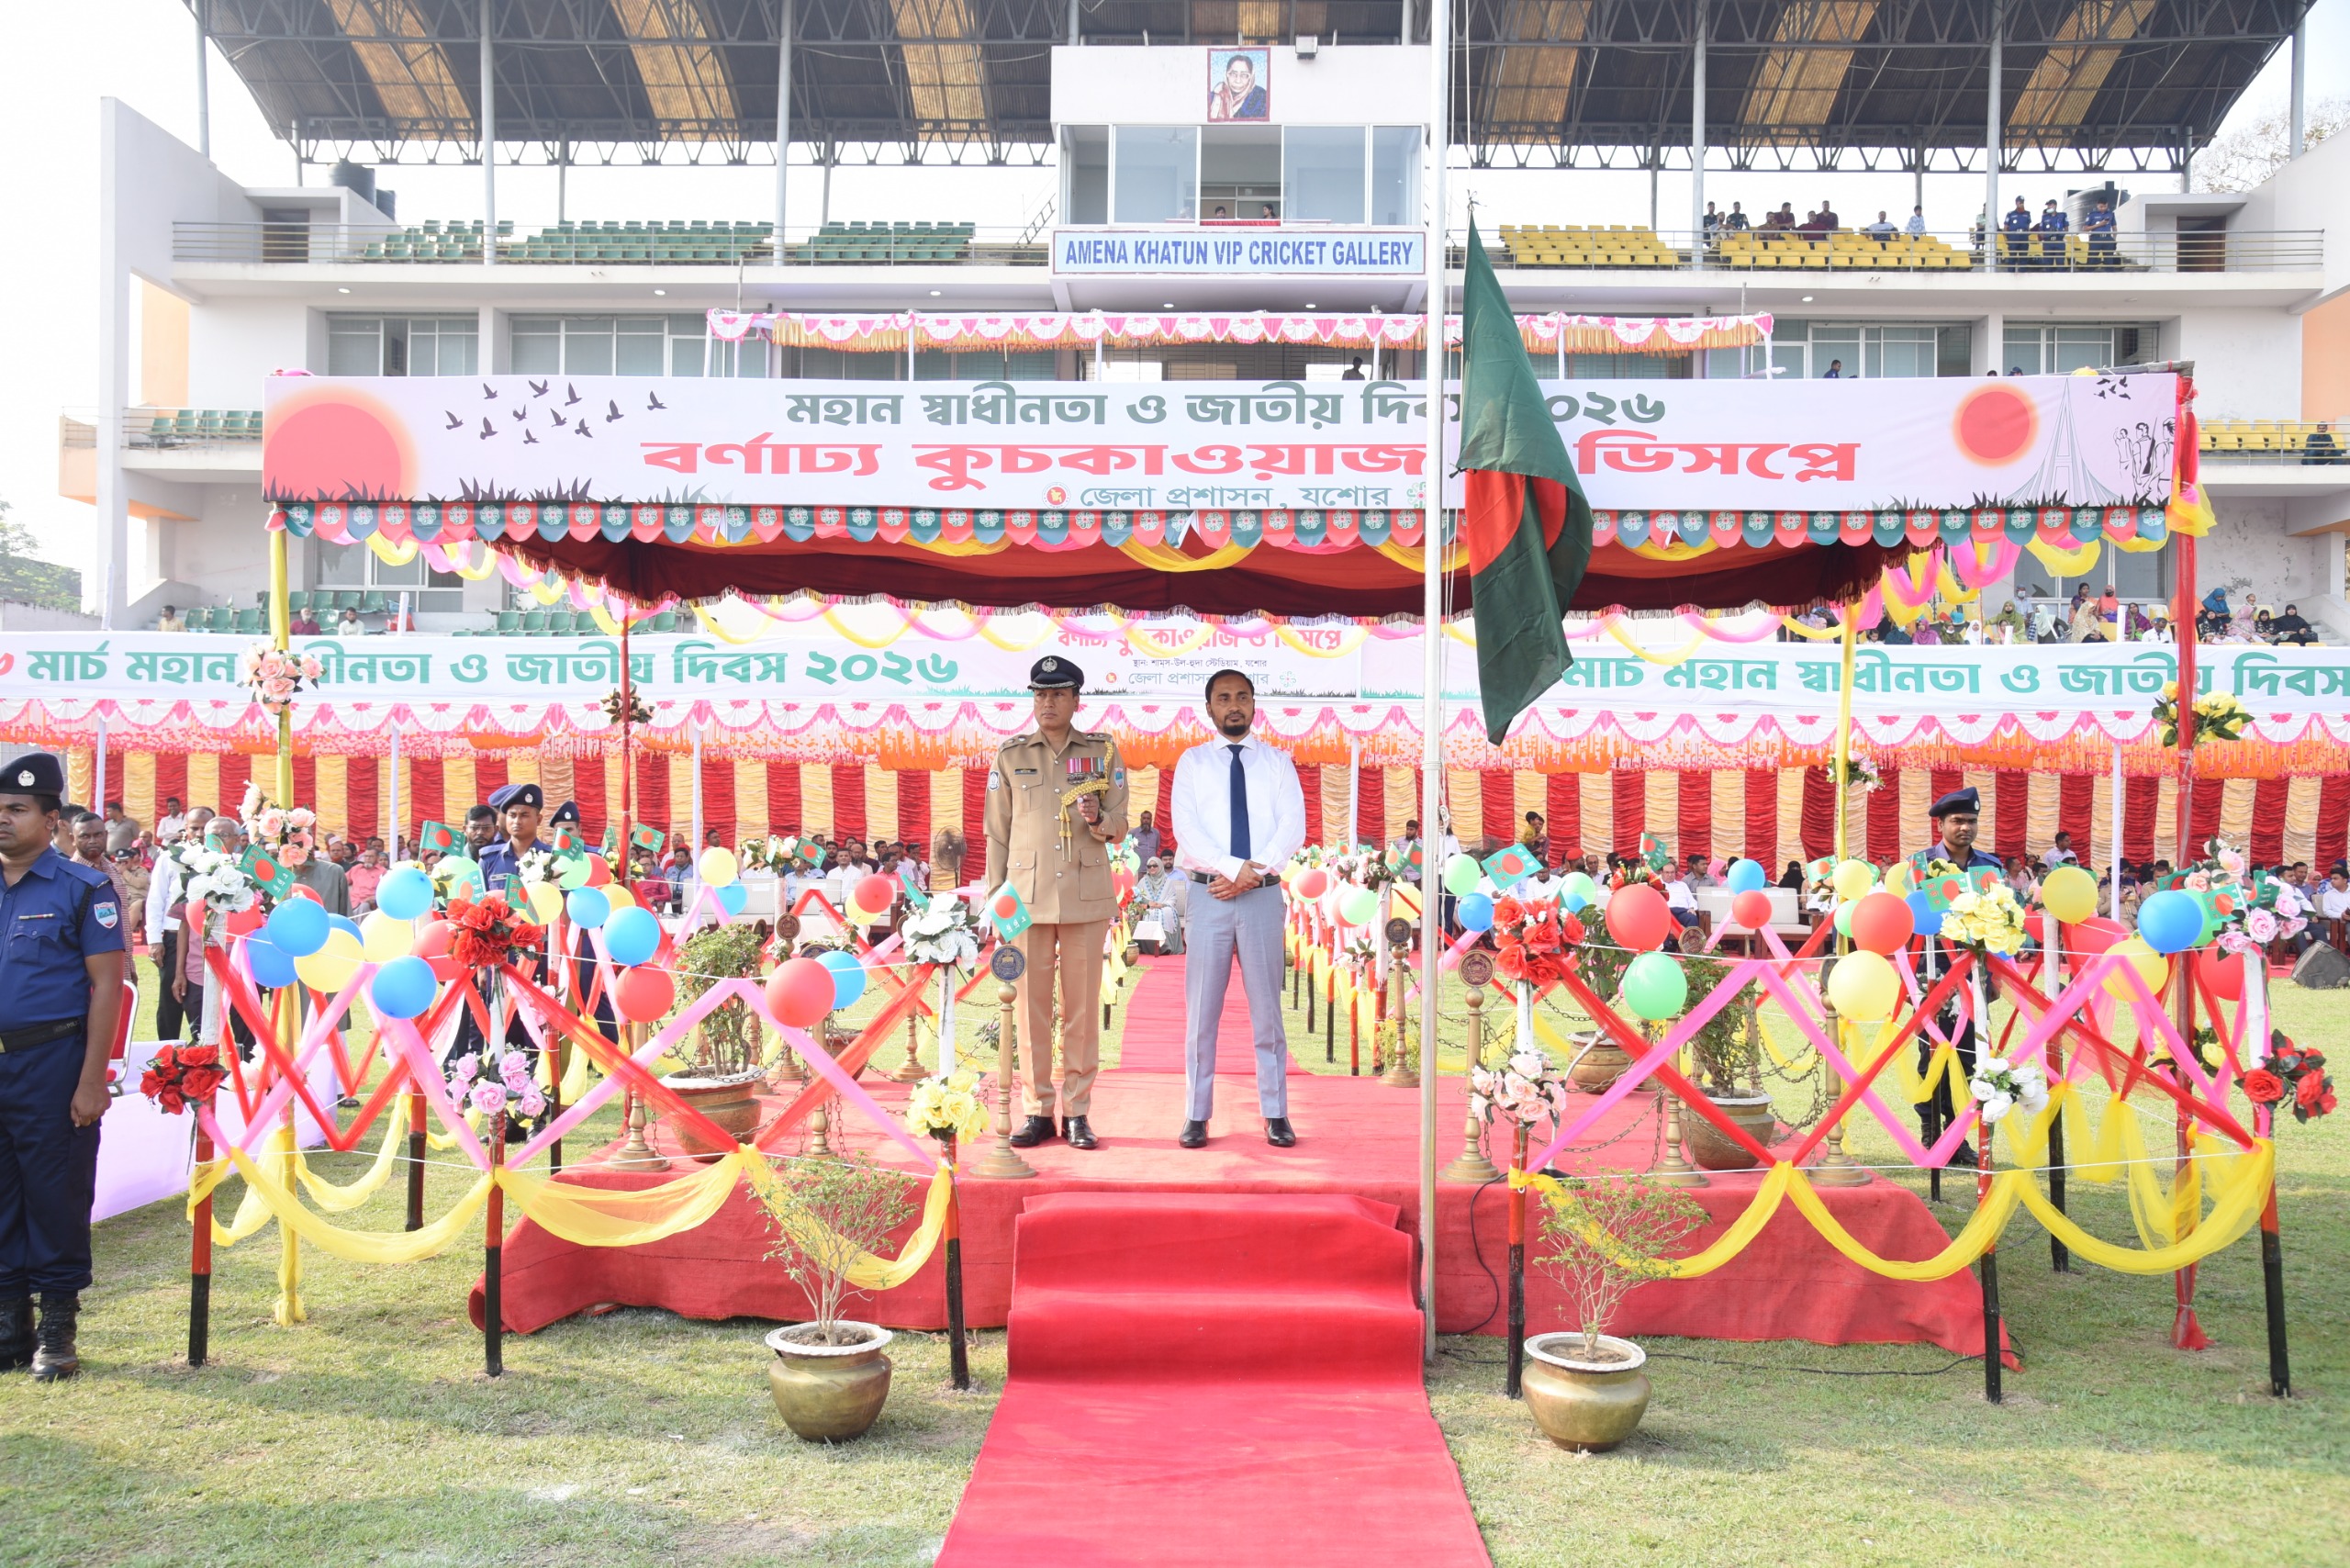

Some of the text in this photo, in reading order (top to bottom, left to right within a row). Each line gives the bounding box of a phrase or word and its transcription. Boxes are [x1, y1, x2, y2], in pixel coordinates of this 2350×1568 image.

[1065, 240, 1415, 265] AMENA KHATUN VIP CRICKET GALLERY
[786, 395, 903, 426] মহান
[921, 382, 1107, 426] স্বাধীনতা
[1125, 396, 1167, 425] ও
[1185, 381, 1343, 430] জাতীয়
[1545, 391, 1666, 426] ০২৬
[640, 429, 1862, 491] বর্ণাঢ্য কুচকাওয়াজ ডিসপ্লে
[1080, 487, 1157, 508] জেলা
[1300, 486, 1393, 509] যশোর
[27, 641, 109, 681] মার্চ
[125, 651, 238, 684] মহান
[450, 654, 488, 683] ও
[506, 640, 655, 688] জাতীয়
[671, 640, 789, 684] দিবস
[804, 651, 959, 685] ২০২৬
[1128, 672, 1164, 685] জেলা
[1796, 648, 1983, 694] স্বাধীনতা
[2000, 663, 2041, 693] ও
[2231, 651, 2350, 697] দিবস
